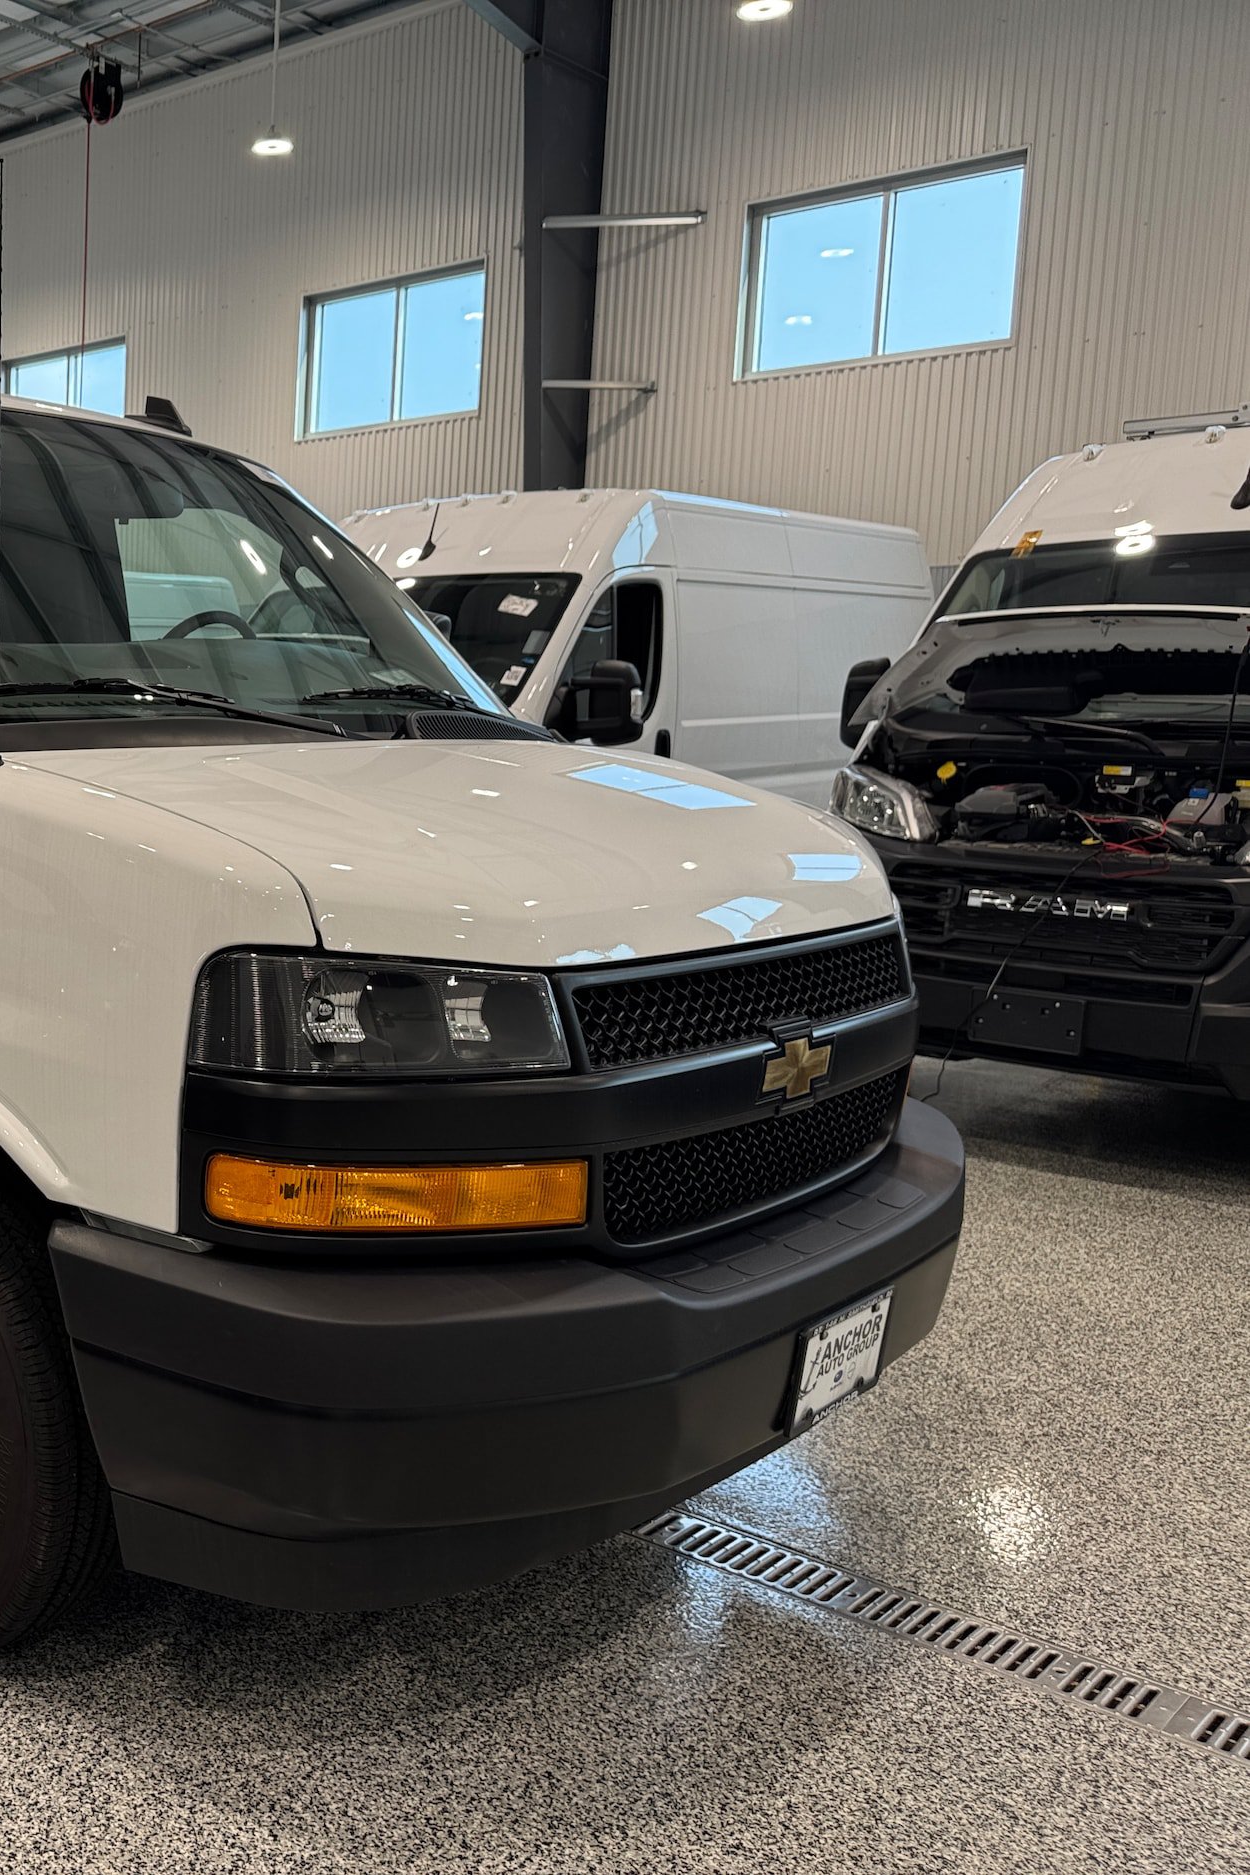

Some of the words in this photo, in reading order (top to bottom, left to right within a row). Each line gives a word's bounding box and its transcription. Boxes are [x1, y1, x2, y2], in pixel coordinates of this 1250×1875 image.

[966, 888, 1130, 922] RAM
[816, 1352, 845, 1379] AUTO
[846, 1333, 880, 1361] GROUP
[821, 1313, 882, 1364] ANCHOR
[812, 1390, 860, 1425] ANCHOR
